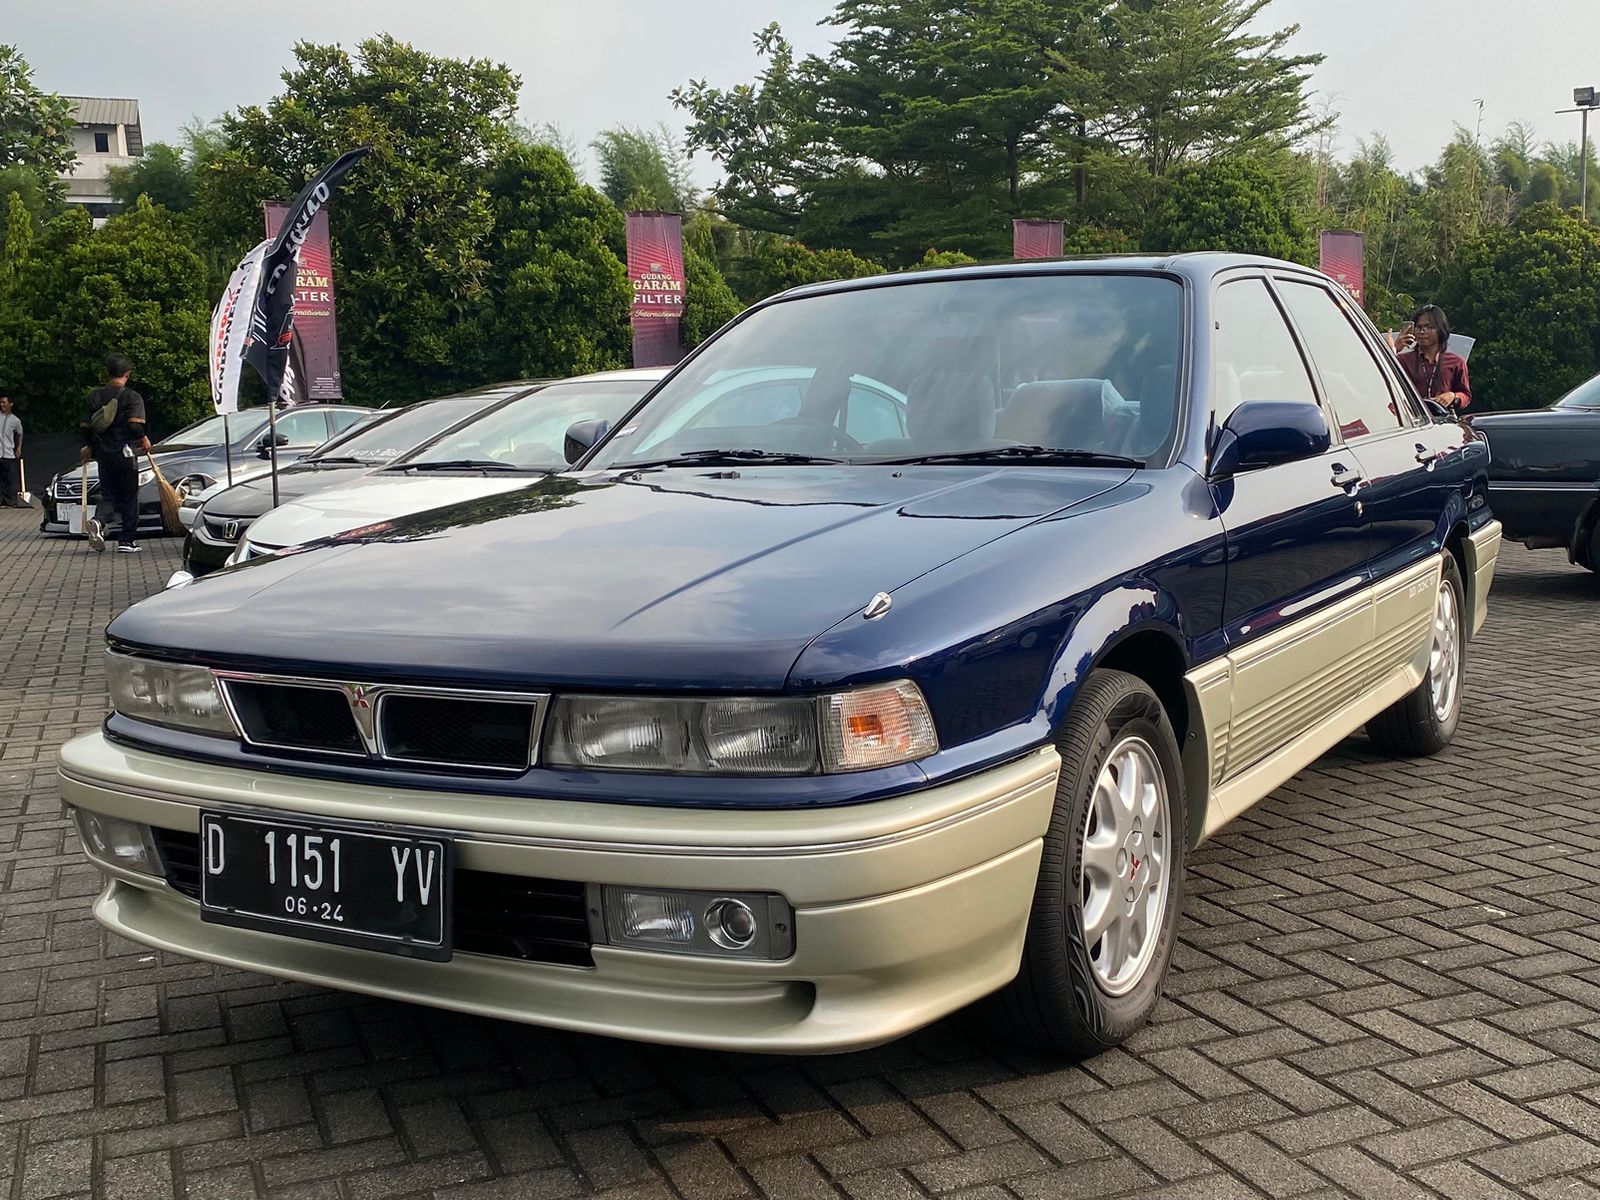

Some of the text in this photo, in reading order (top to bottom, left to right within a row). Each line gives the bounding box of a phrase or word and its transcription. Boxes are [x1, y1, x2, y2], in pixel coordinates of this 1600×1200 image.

[296, 276, 329, 287] RAM
[633, 280, 681, 291] GARAM
[295, 291, 330, 302] TER
[633, 294, 682, 304] FILTER
[634, 309, 682, 318] International
[207, 823, 435, 906] D 1151 YV
